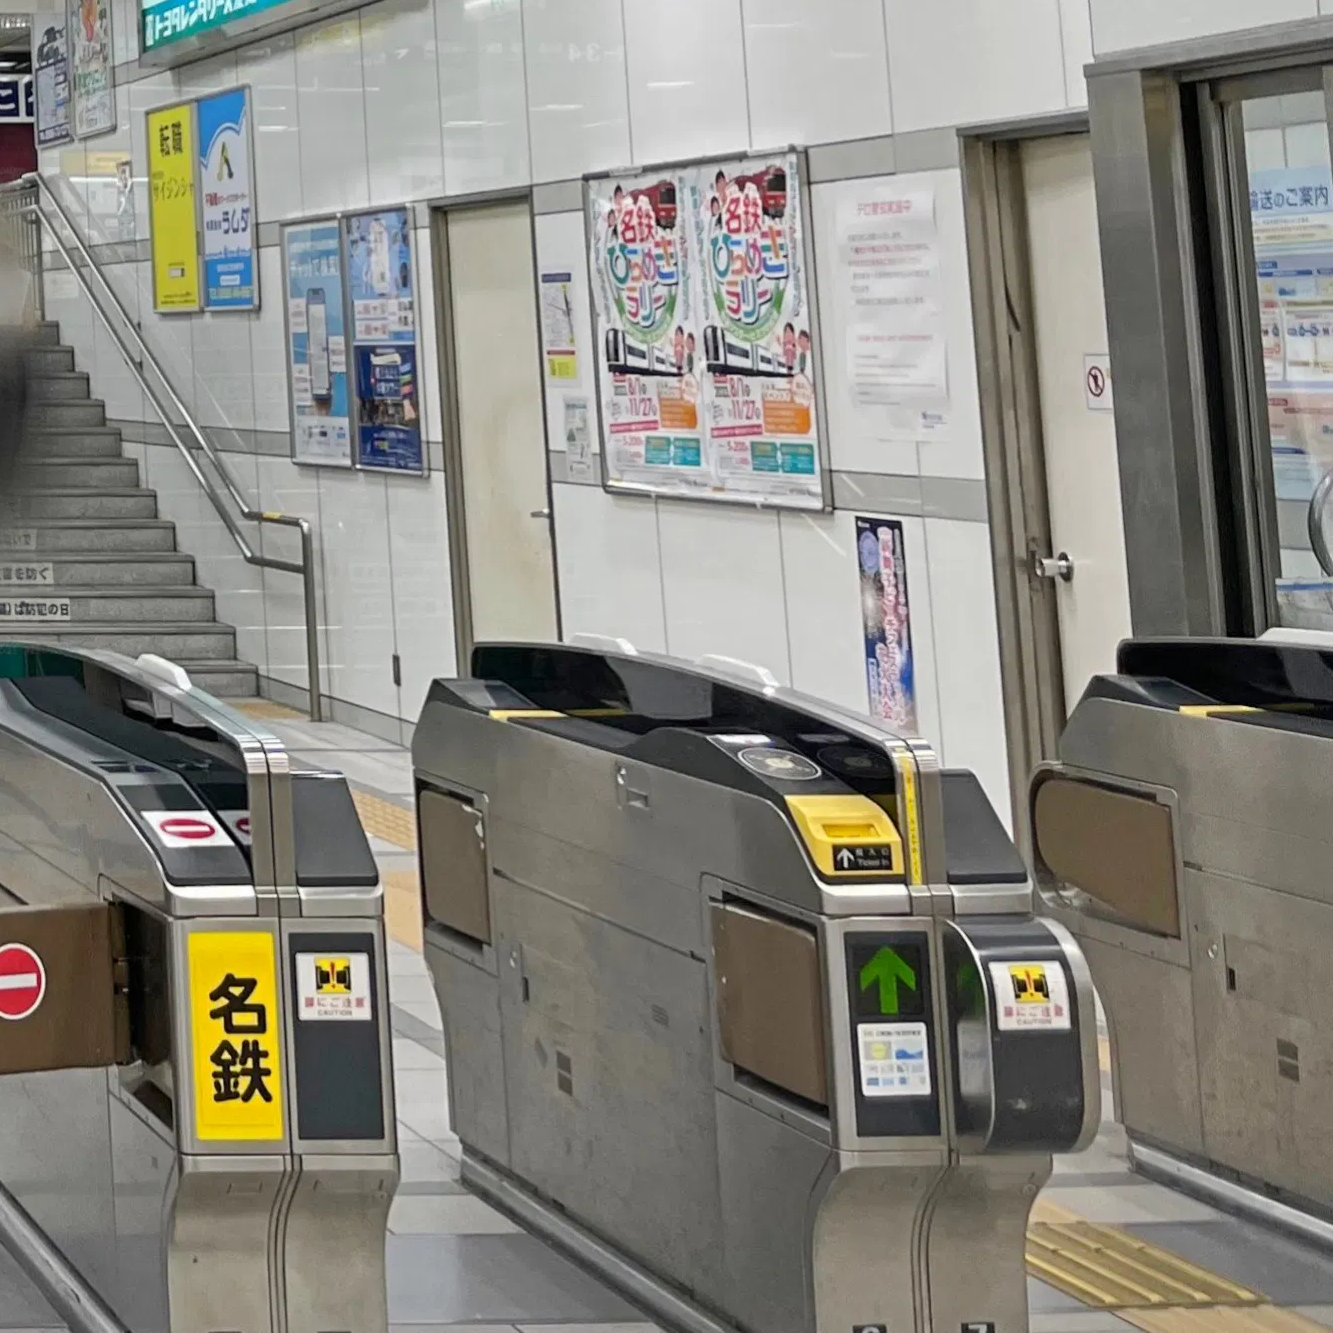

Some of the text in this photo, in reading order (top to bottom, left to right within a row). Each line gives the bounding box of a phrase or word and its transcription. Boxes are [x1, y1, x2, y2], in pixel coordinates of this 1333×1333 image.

[620, 207, 656, 244] 名鉄
[724, 193, 762, 234] 名鉄
[607, 237, 679, 285] ひらめき
[710, 225, 789, 279] ひらめき
[625, 284, 665, 327] ラリー
[724, 278, 772, 324] ラリー
[208, 972, 273, 1104] 名鉄
